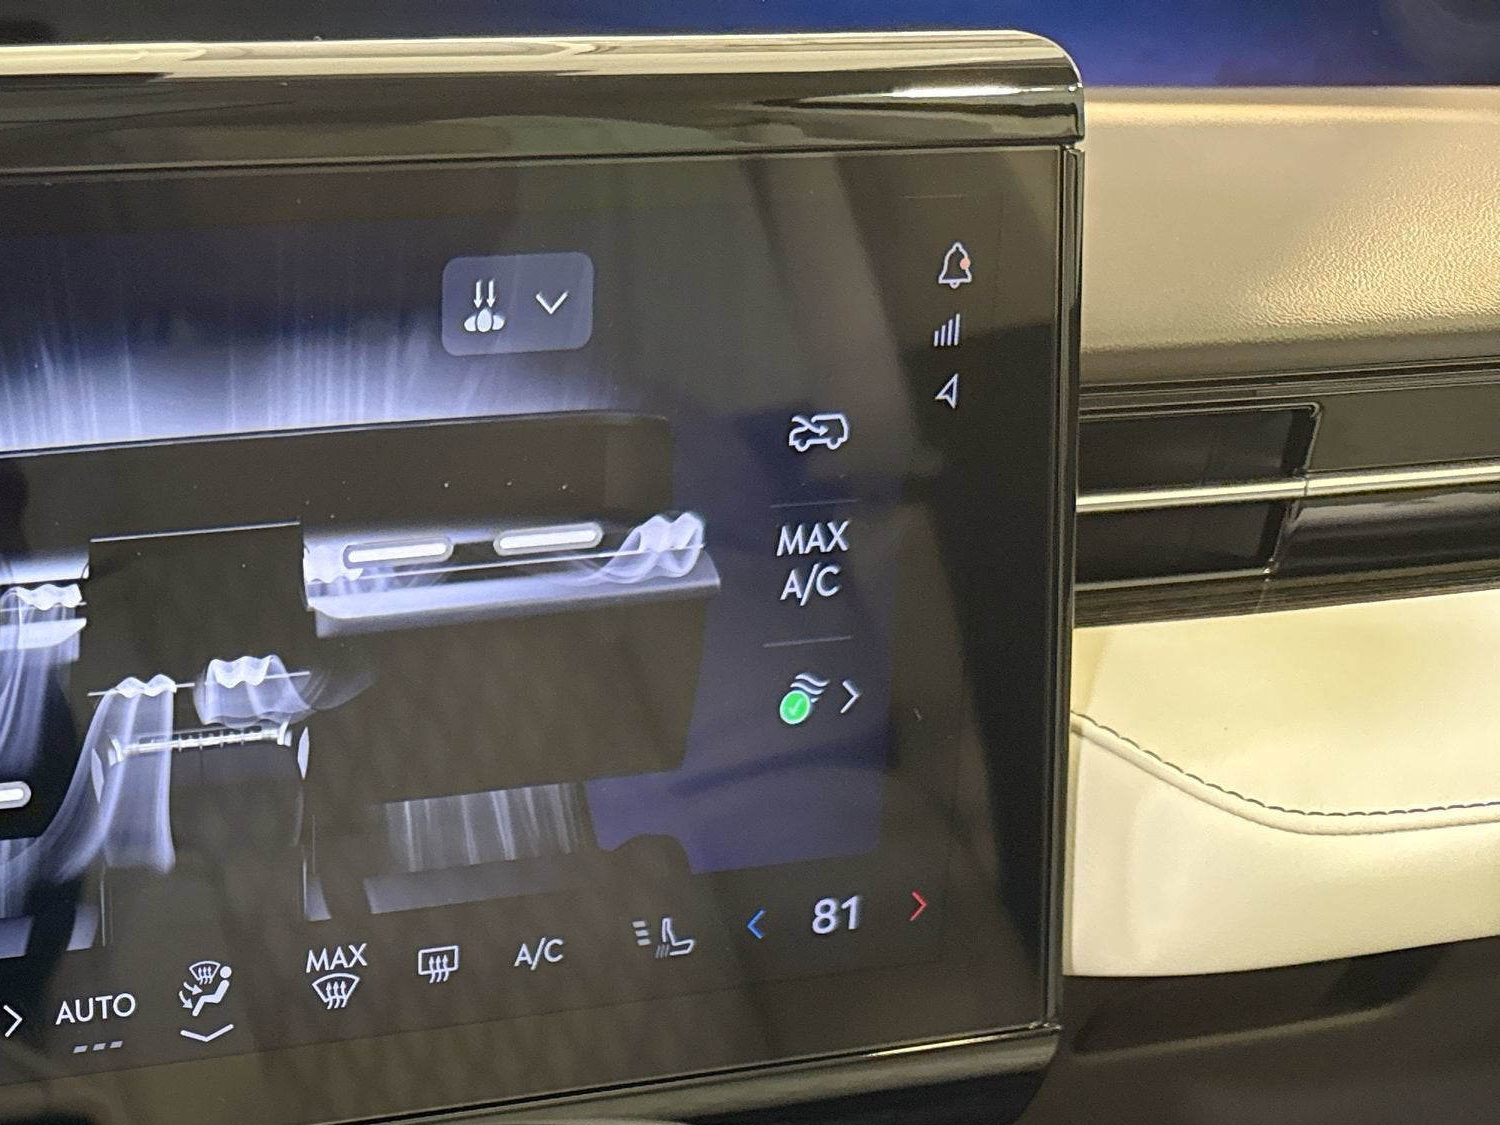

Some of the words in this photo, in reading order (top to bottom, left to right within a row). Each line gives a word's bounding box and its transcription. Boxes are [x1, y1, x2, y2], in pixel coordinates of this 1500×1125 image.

[777, 520, 849, 557] MAX
[780, 563, 840, 606] A/C
[812, 895, 858, 934] 81
[306, 943, 368, 972] MAX
[514, 937, 564, 970] A/C
[55, 992, 136, 1025] AUTO
